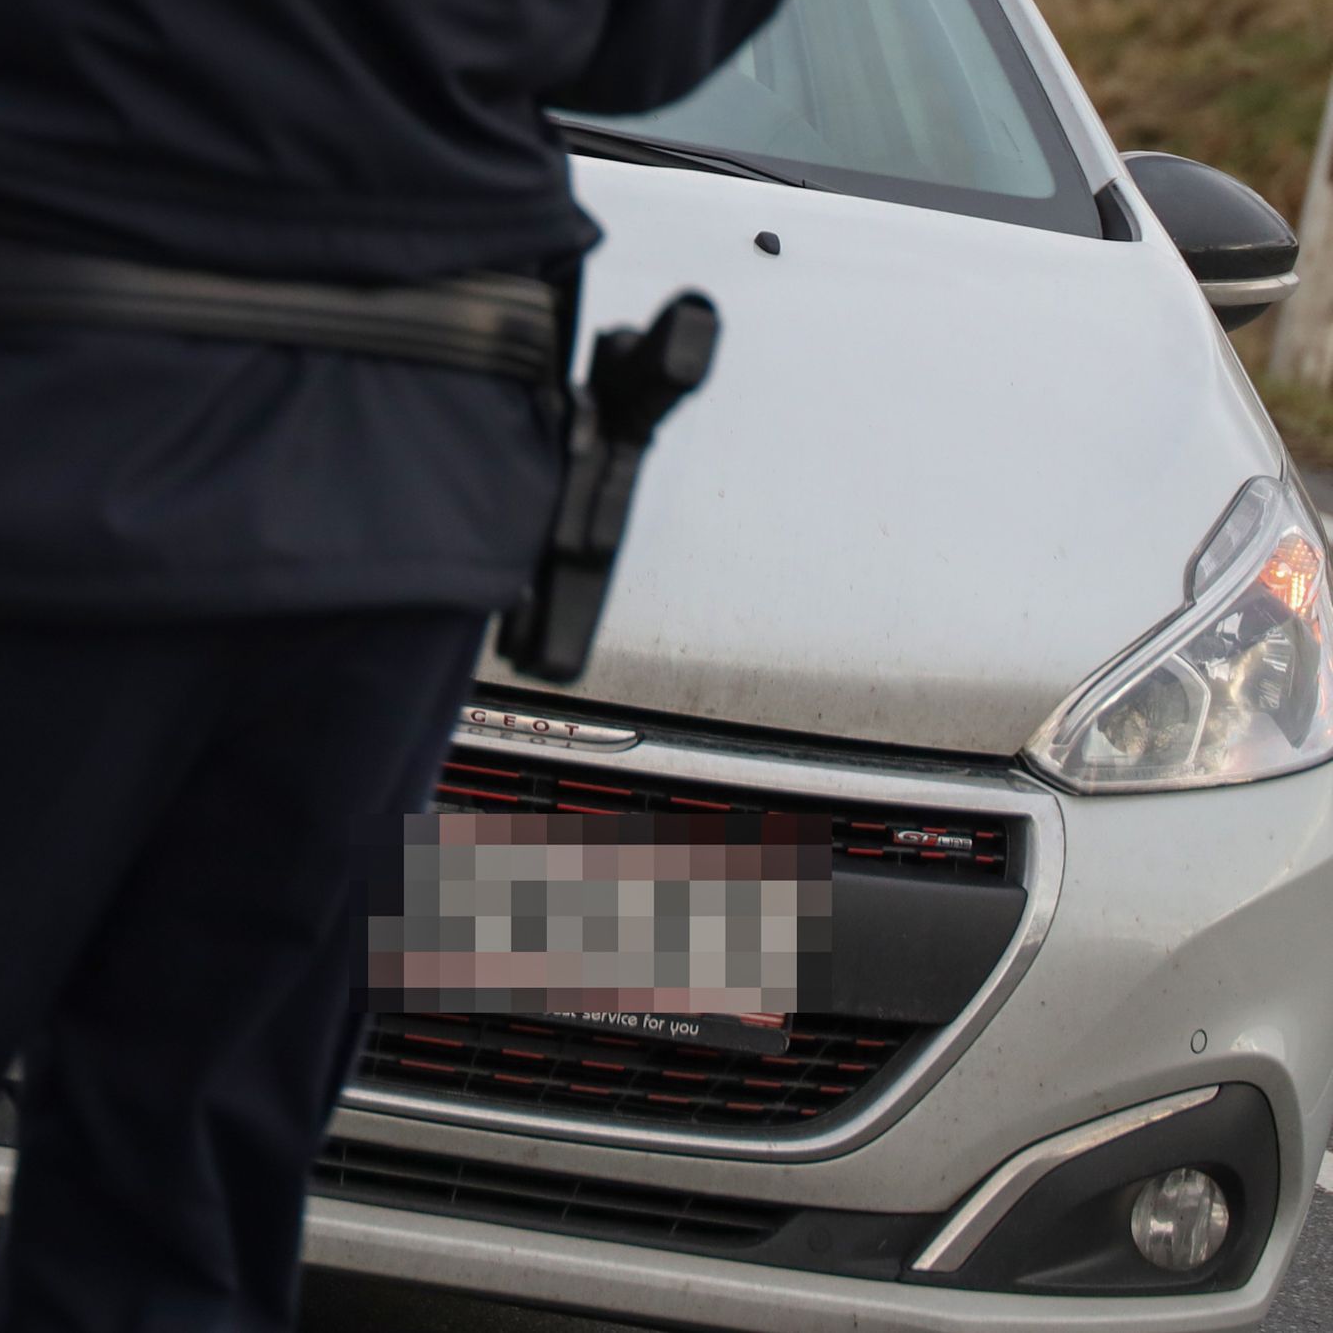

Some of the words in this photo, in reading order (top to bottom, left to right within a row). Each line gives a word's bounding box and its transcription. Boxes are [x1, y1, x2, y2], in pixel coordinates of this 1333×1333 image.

[469, 709, 580, 737] GEOT
[642, 1013, 665, 1032] for
[669, 1020, 700, 1037] you
